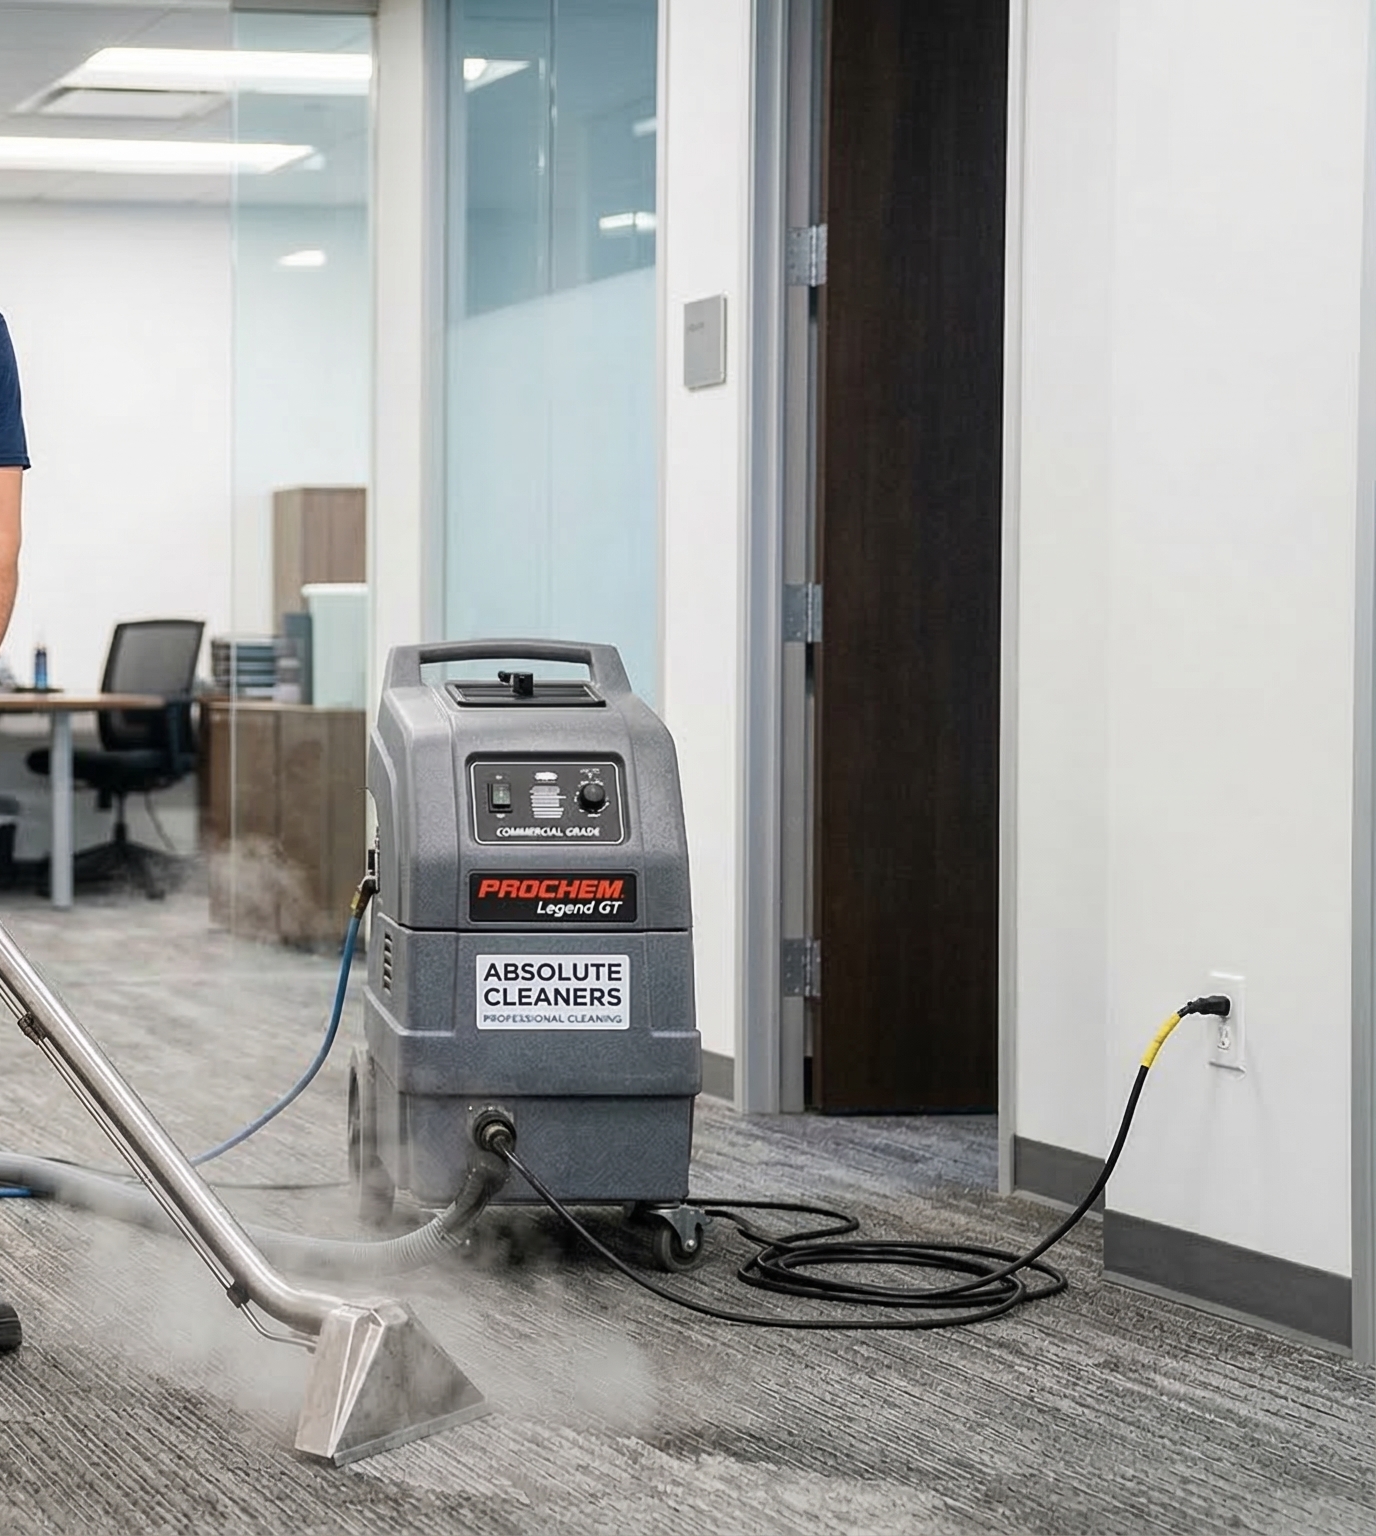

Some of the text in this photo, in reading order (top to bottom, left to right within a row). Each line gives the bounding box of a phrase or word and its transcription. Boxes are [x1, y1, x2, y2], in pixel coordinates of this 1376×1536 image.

[496, 826, 600, 838] COMMERCIAL GRADE
[537, 901, 623, 917] Legend GT
[483, 963, 622, 982] ABSOLUTE
[483, 987, 622, 1007] CLEANERS
